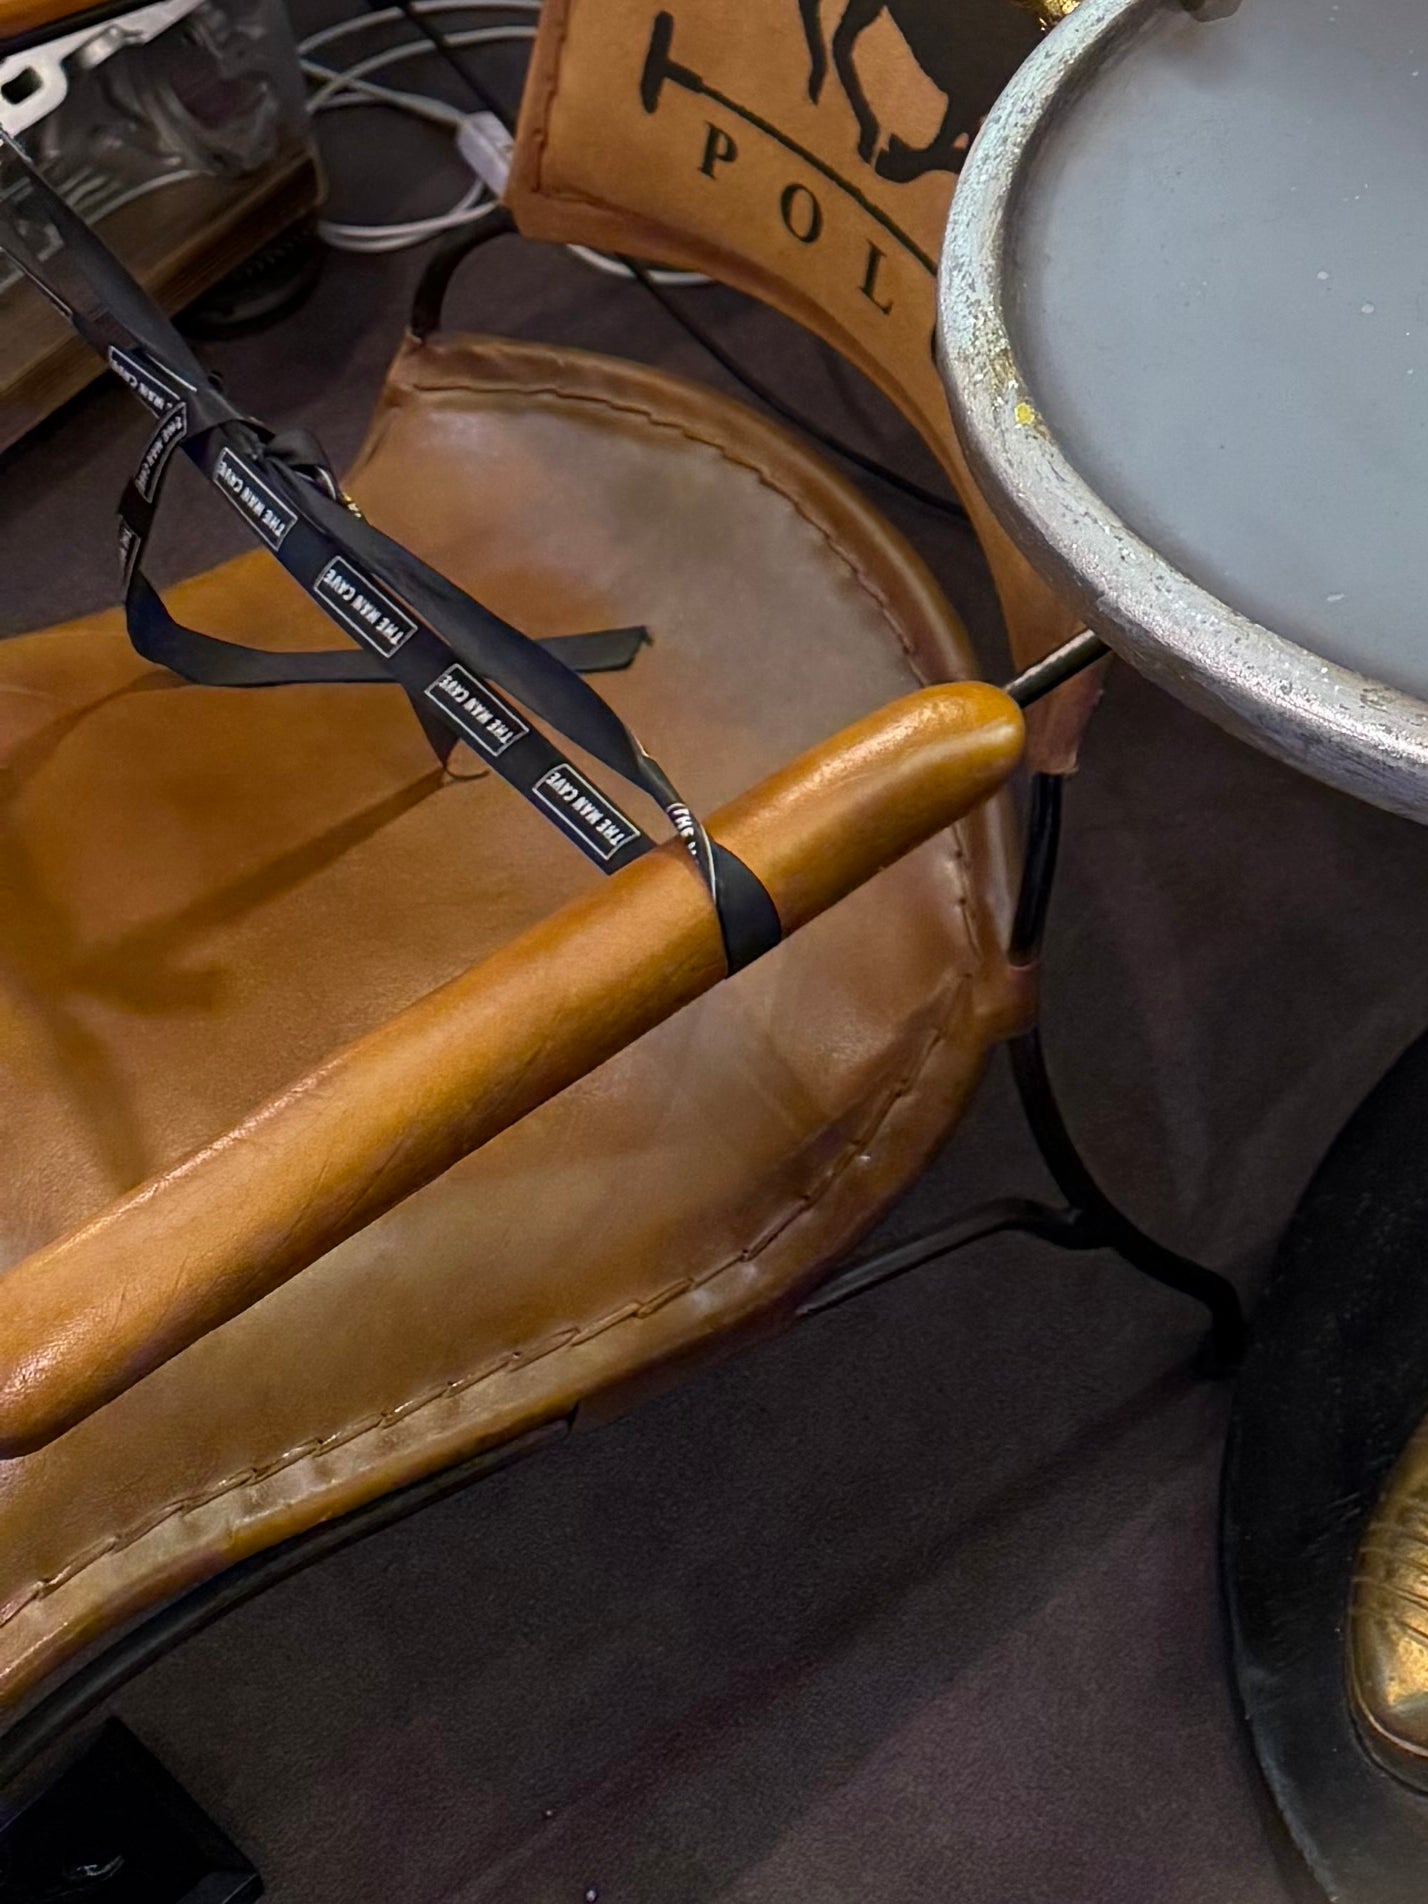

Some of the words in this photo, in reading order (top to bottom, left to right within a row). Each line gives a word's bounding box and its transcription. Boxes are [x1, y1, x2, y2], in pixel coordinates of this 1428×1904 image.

[700, 117, 898, 319] POL
[239, 486, 265, 517] MAN
[261, 508, 286, 538] THE
[322, 568, 356, 601] CAVE
[350, 594, 383, 625] MAN
[375, 616, 405, 646] THE
[438, 674, 470, 704] CAVE
[464, 697, 494, 725] MAN
[486, 719, 515, 745] THE
[545, 771, 579, 802] CAVE
[570, 795, 605, 825] MAN
[595, 817, 626, 847] THE
